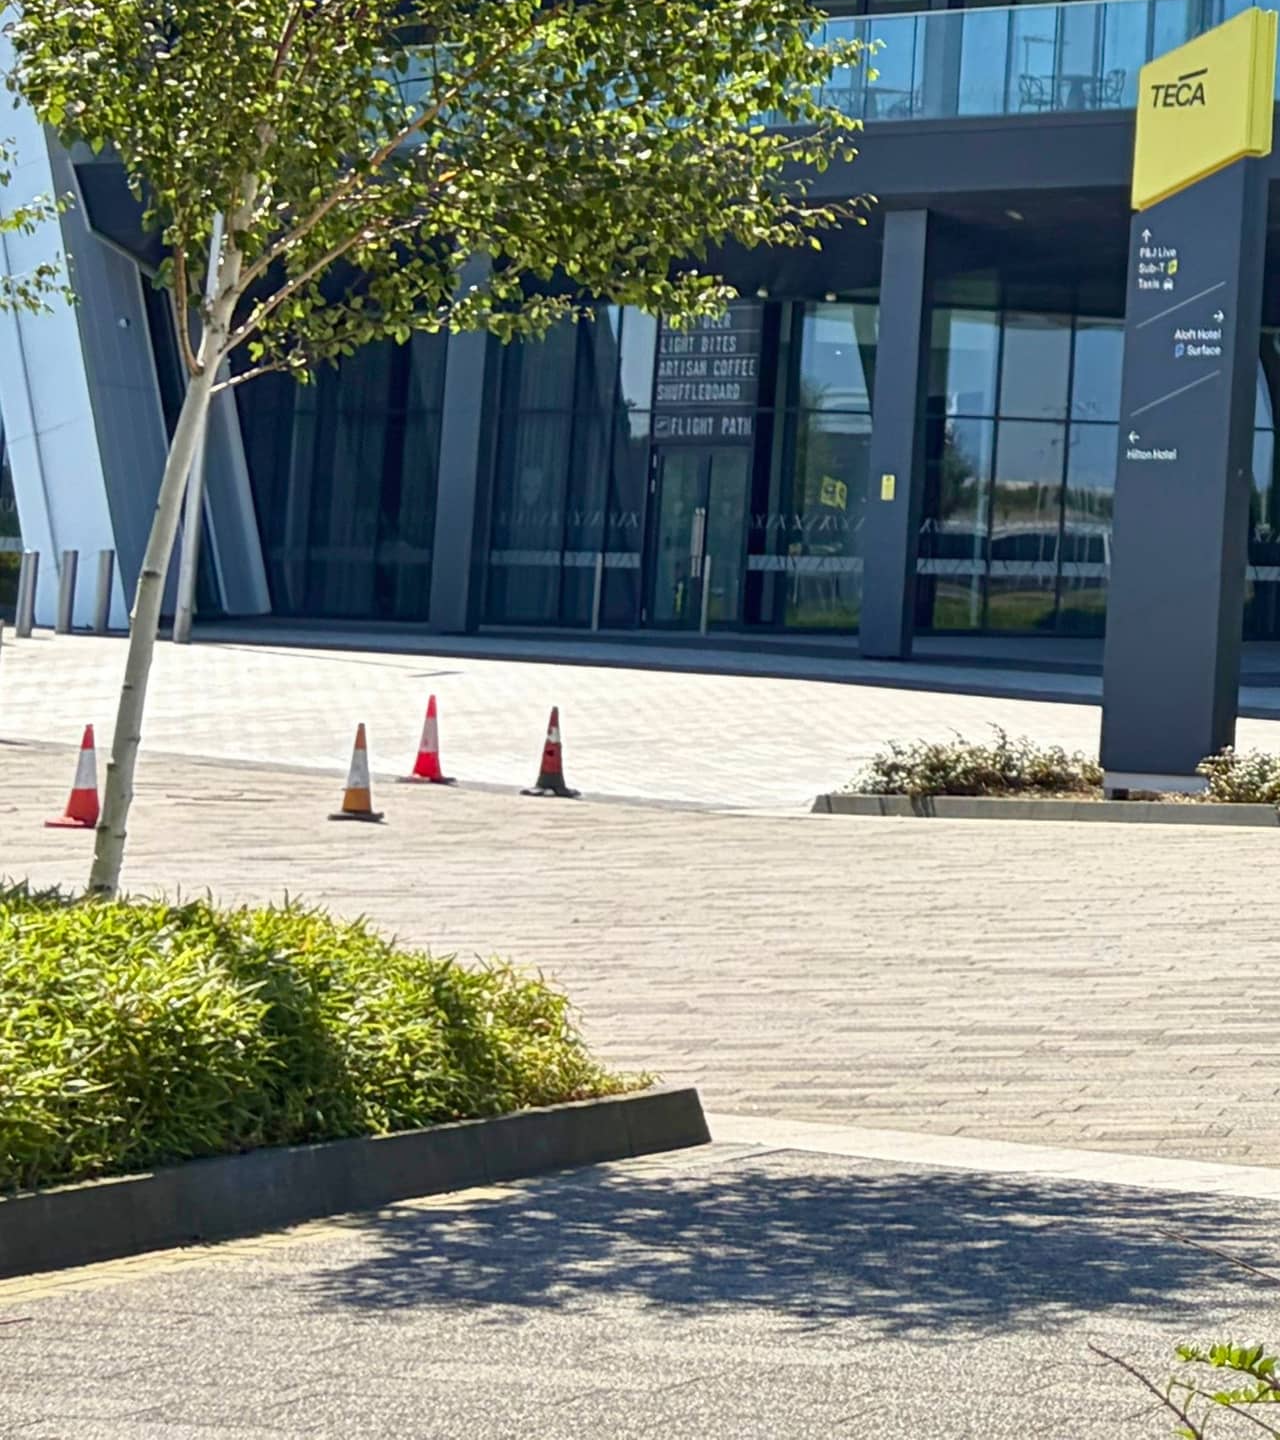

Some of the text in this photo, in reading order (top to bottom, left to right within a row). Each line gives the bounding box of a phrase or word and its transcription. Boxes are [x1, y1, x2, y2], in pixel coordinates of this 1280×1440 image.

[1151, 81, 1206, 108] TECA
[1158, 246, 1177, 257] Live
[1139, 262, 1165, 274] Sub-T
[1139, 278, 1160, 289] Taxis
[1174, 329, 1222, 340] Aloft Hotel
[660, 335, 737, 353] LIGHT BITES
[1187, 344, 1221, 356] Surface
[659, 359, 755, 377] ARTISAN COFFEE
[657, 383, 741, 401] SHUFFLEBOARD
[671, 416, 752, 436] FLIGHT PATH
[1127, 448, 1177, 460] Hilton Hotel
